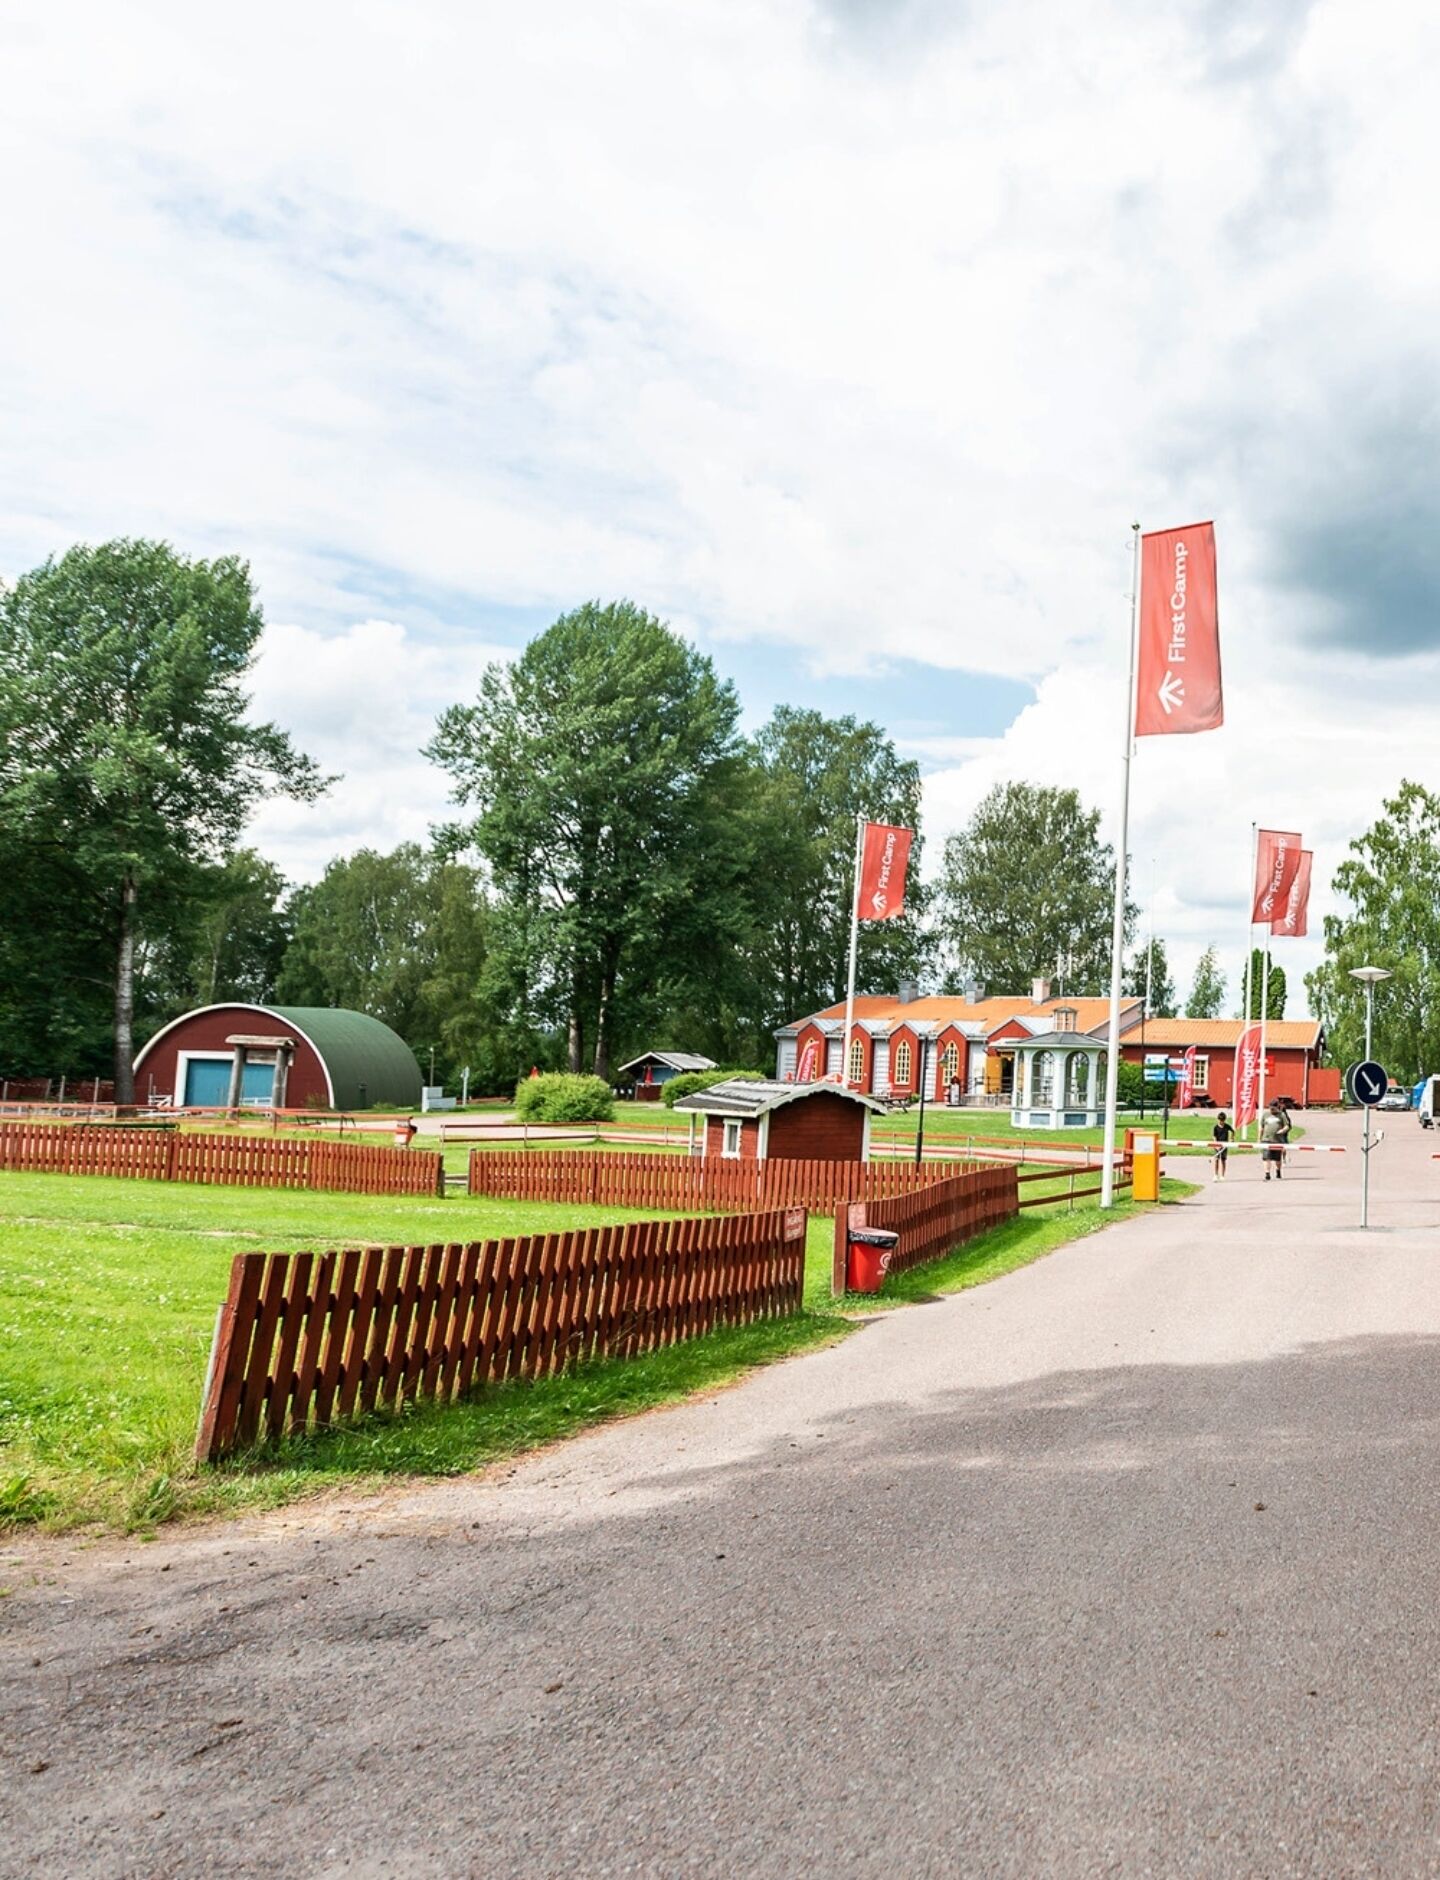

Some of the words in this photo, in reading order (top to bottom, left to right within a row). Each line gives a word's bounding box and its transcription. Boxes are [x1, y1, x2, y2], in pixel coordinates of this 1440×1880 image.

[1170, 542, 1188, 609] Camp
[1168, 610, 1186, 662] First
[882, 833, 896, 865] Camp
[878, 866, 891, 889] First
